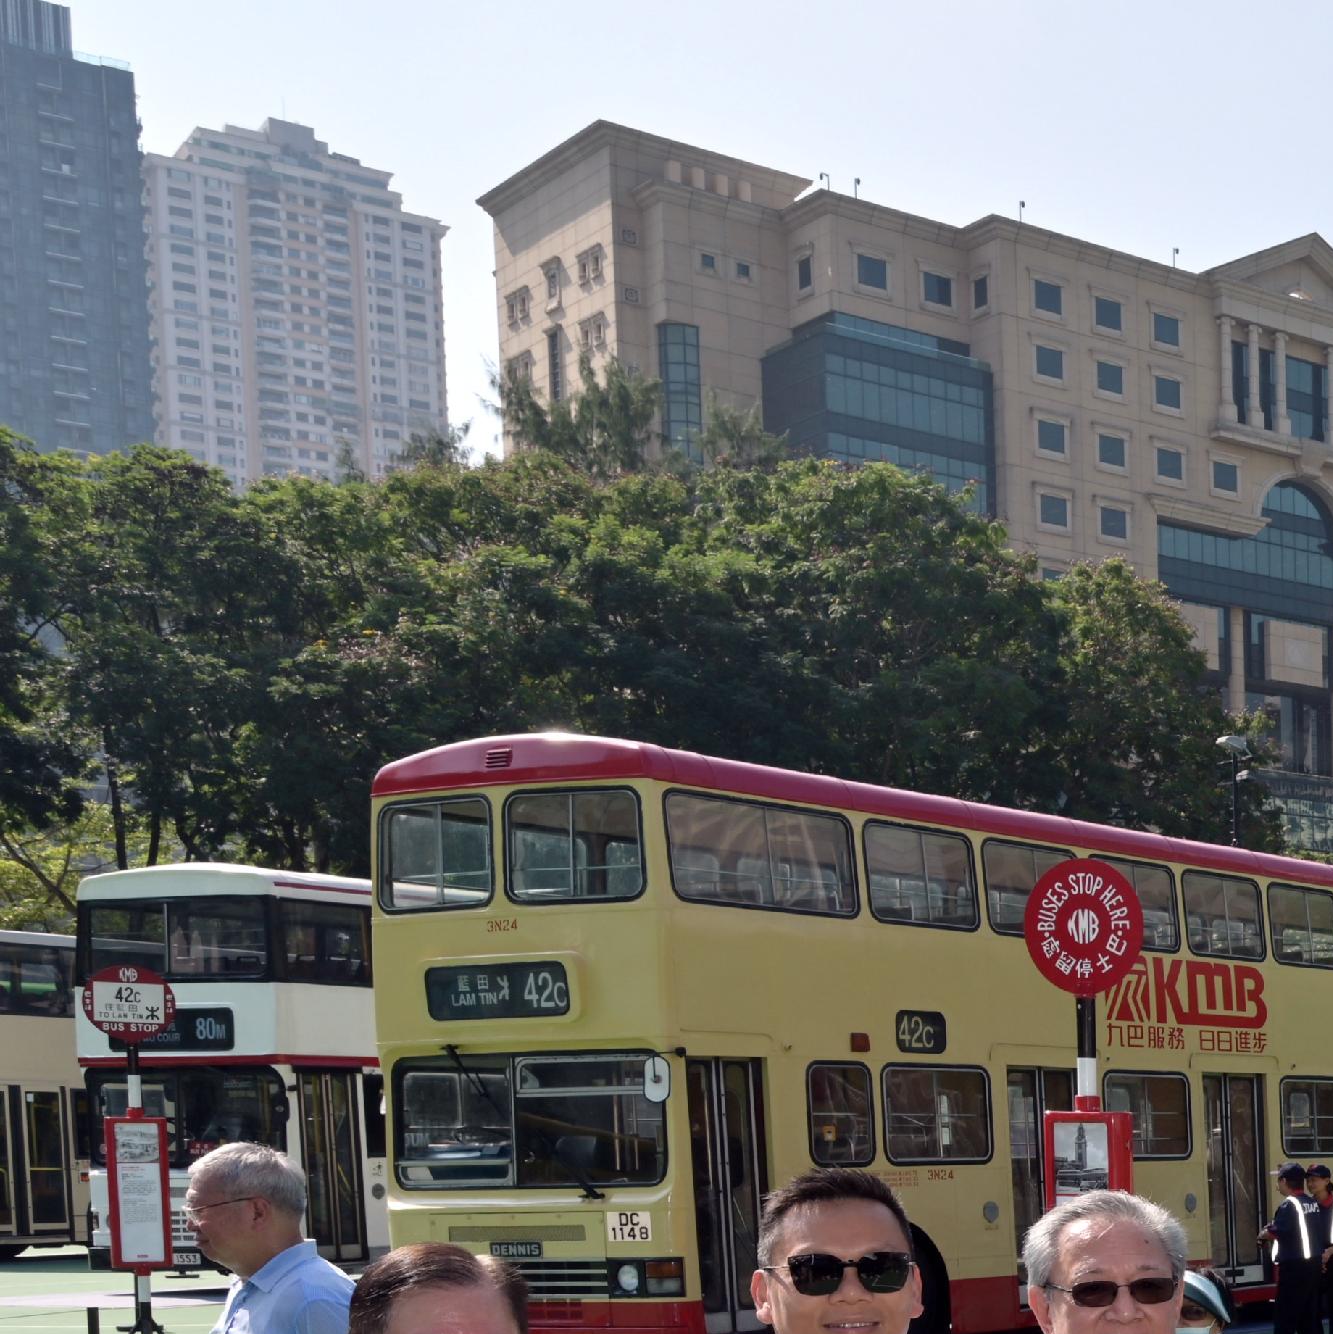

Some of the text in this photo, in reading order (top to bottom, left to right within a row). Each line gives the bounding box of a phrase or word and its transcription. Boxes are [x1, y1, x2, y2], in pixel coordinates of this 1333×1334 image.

[1037, 872, 1130, 931] BUSES STOP HERE
[487, 919, 518, 932] 3N24
[1067, 908, 1099, 944] KMB
[451, 992, 498, 1007] LAM TIN
[1152, 956, 1268, 1030] KMB
[103, 1022, 125, 1031] BUS
[130, 1023, 159, 1032] STOP
[195, 1017, 226, 1040] 80M
[1107, 1023, 1268, 1054] 九巴服務 日日進步
[927, 1168, 954, 1181] 3N24
[619, 1212, 640, 1227] DC
[612, 1227, 649, 1240] 1148
[492, 1243, 540, 1256] DENNIS
